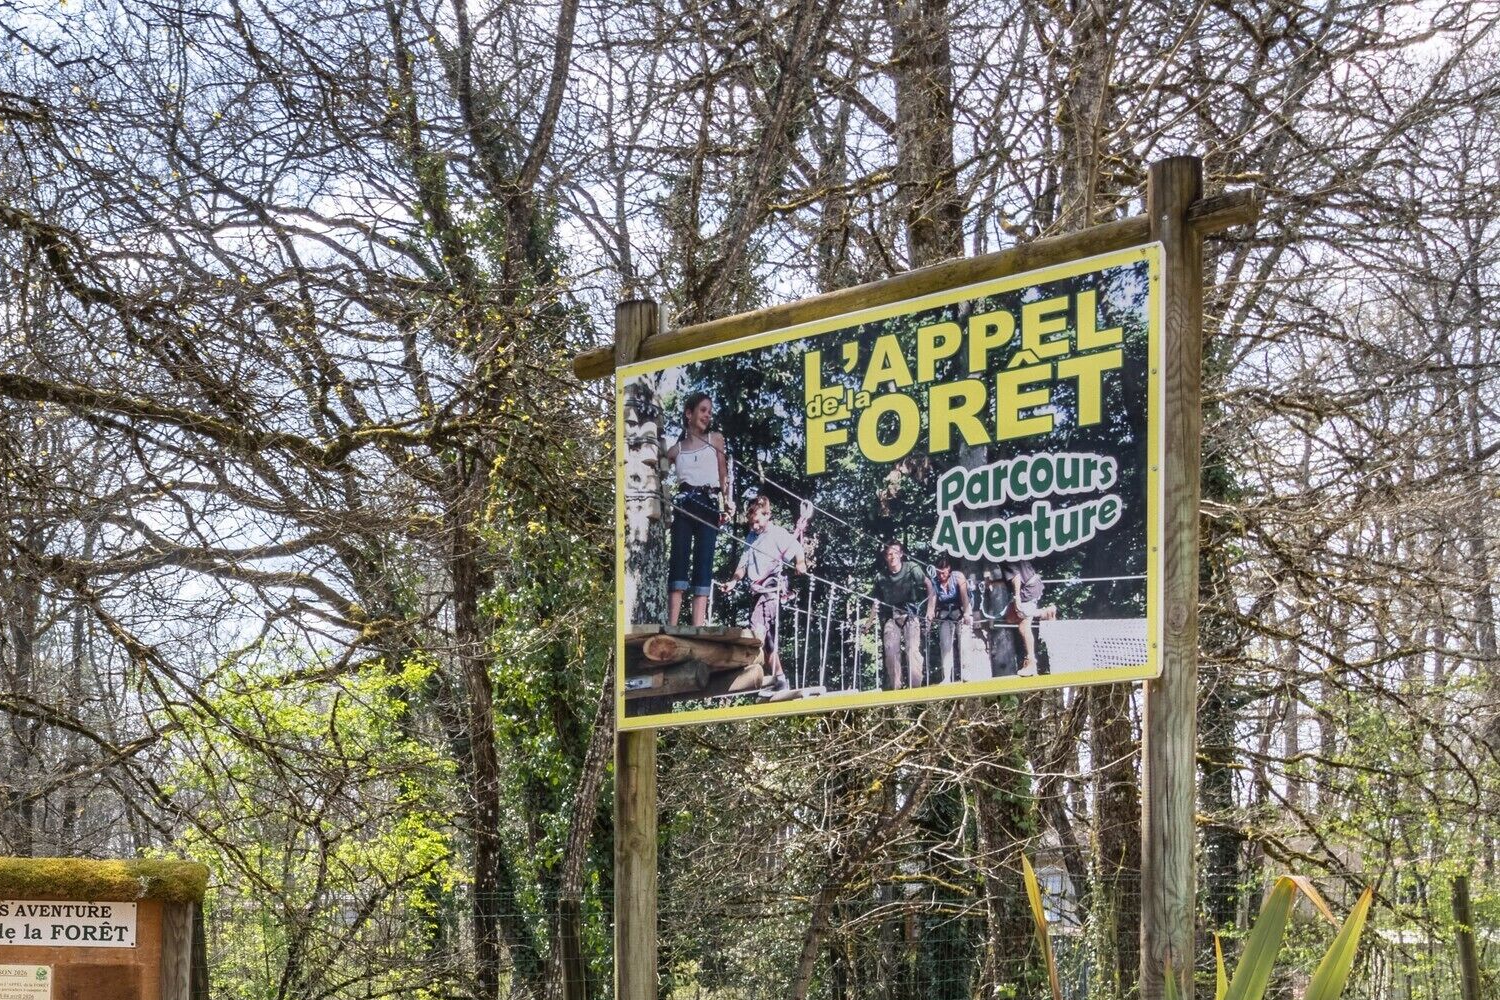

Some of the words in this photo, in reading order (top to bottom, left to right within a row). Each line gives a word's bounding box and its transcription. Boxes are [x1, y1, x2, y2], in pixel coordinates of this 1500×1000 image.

[804, 289, 1124, 397] L'APPEL
[805, 395, 840, 419] de
[845, 387, 872, 411] la
[805, 348, 1123, 476] FORÊT
[941, 456, 1113, 511] Parcours
[936, 498, 1118, 558] Aventure
[15, 905, 112, 919] AVENTURE
[23, 924, 42, 940] la
[50, 921, 129, 942] FORÊT
